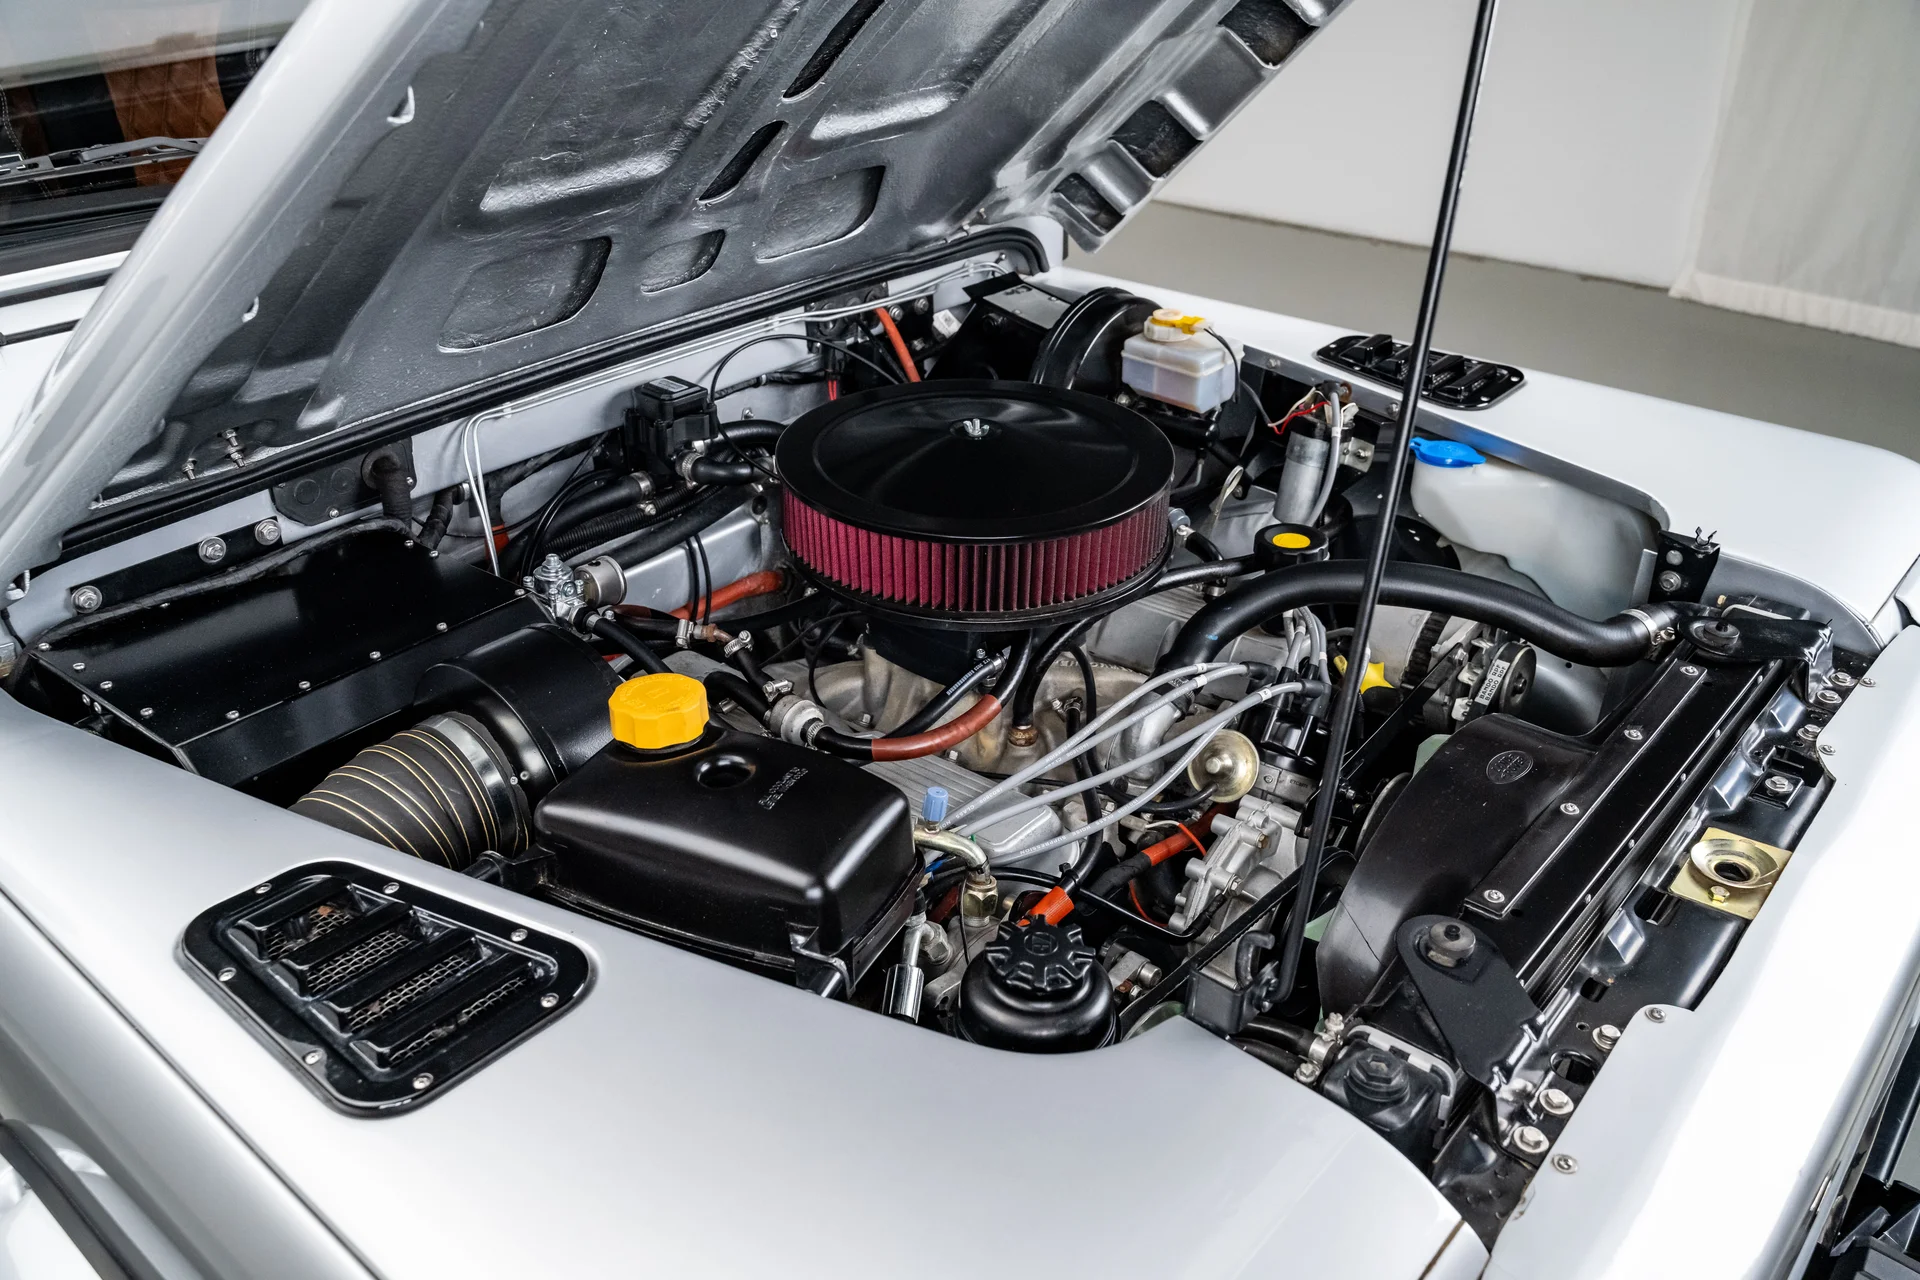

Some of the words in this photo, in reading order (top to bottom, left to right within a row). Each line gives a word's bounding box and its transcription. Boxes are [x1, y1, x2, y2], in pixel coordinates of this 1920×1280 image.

[1479, 678, 1493, 699] BANDO
[1485, 680, 1499, 700] BANDO
[1045, 737, 1080, 762] SUPPRESSION
[955, 804, 975, 819] CLASS
[1072, 826, 1091, 837] NOISE
[1020, 835, 1066, 855] SUPPRESSION
